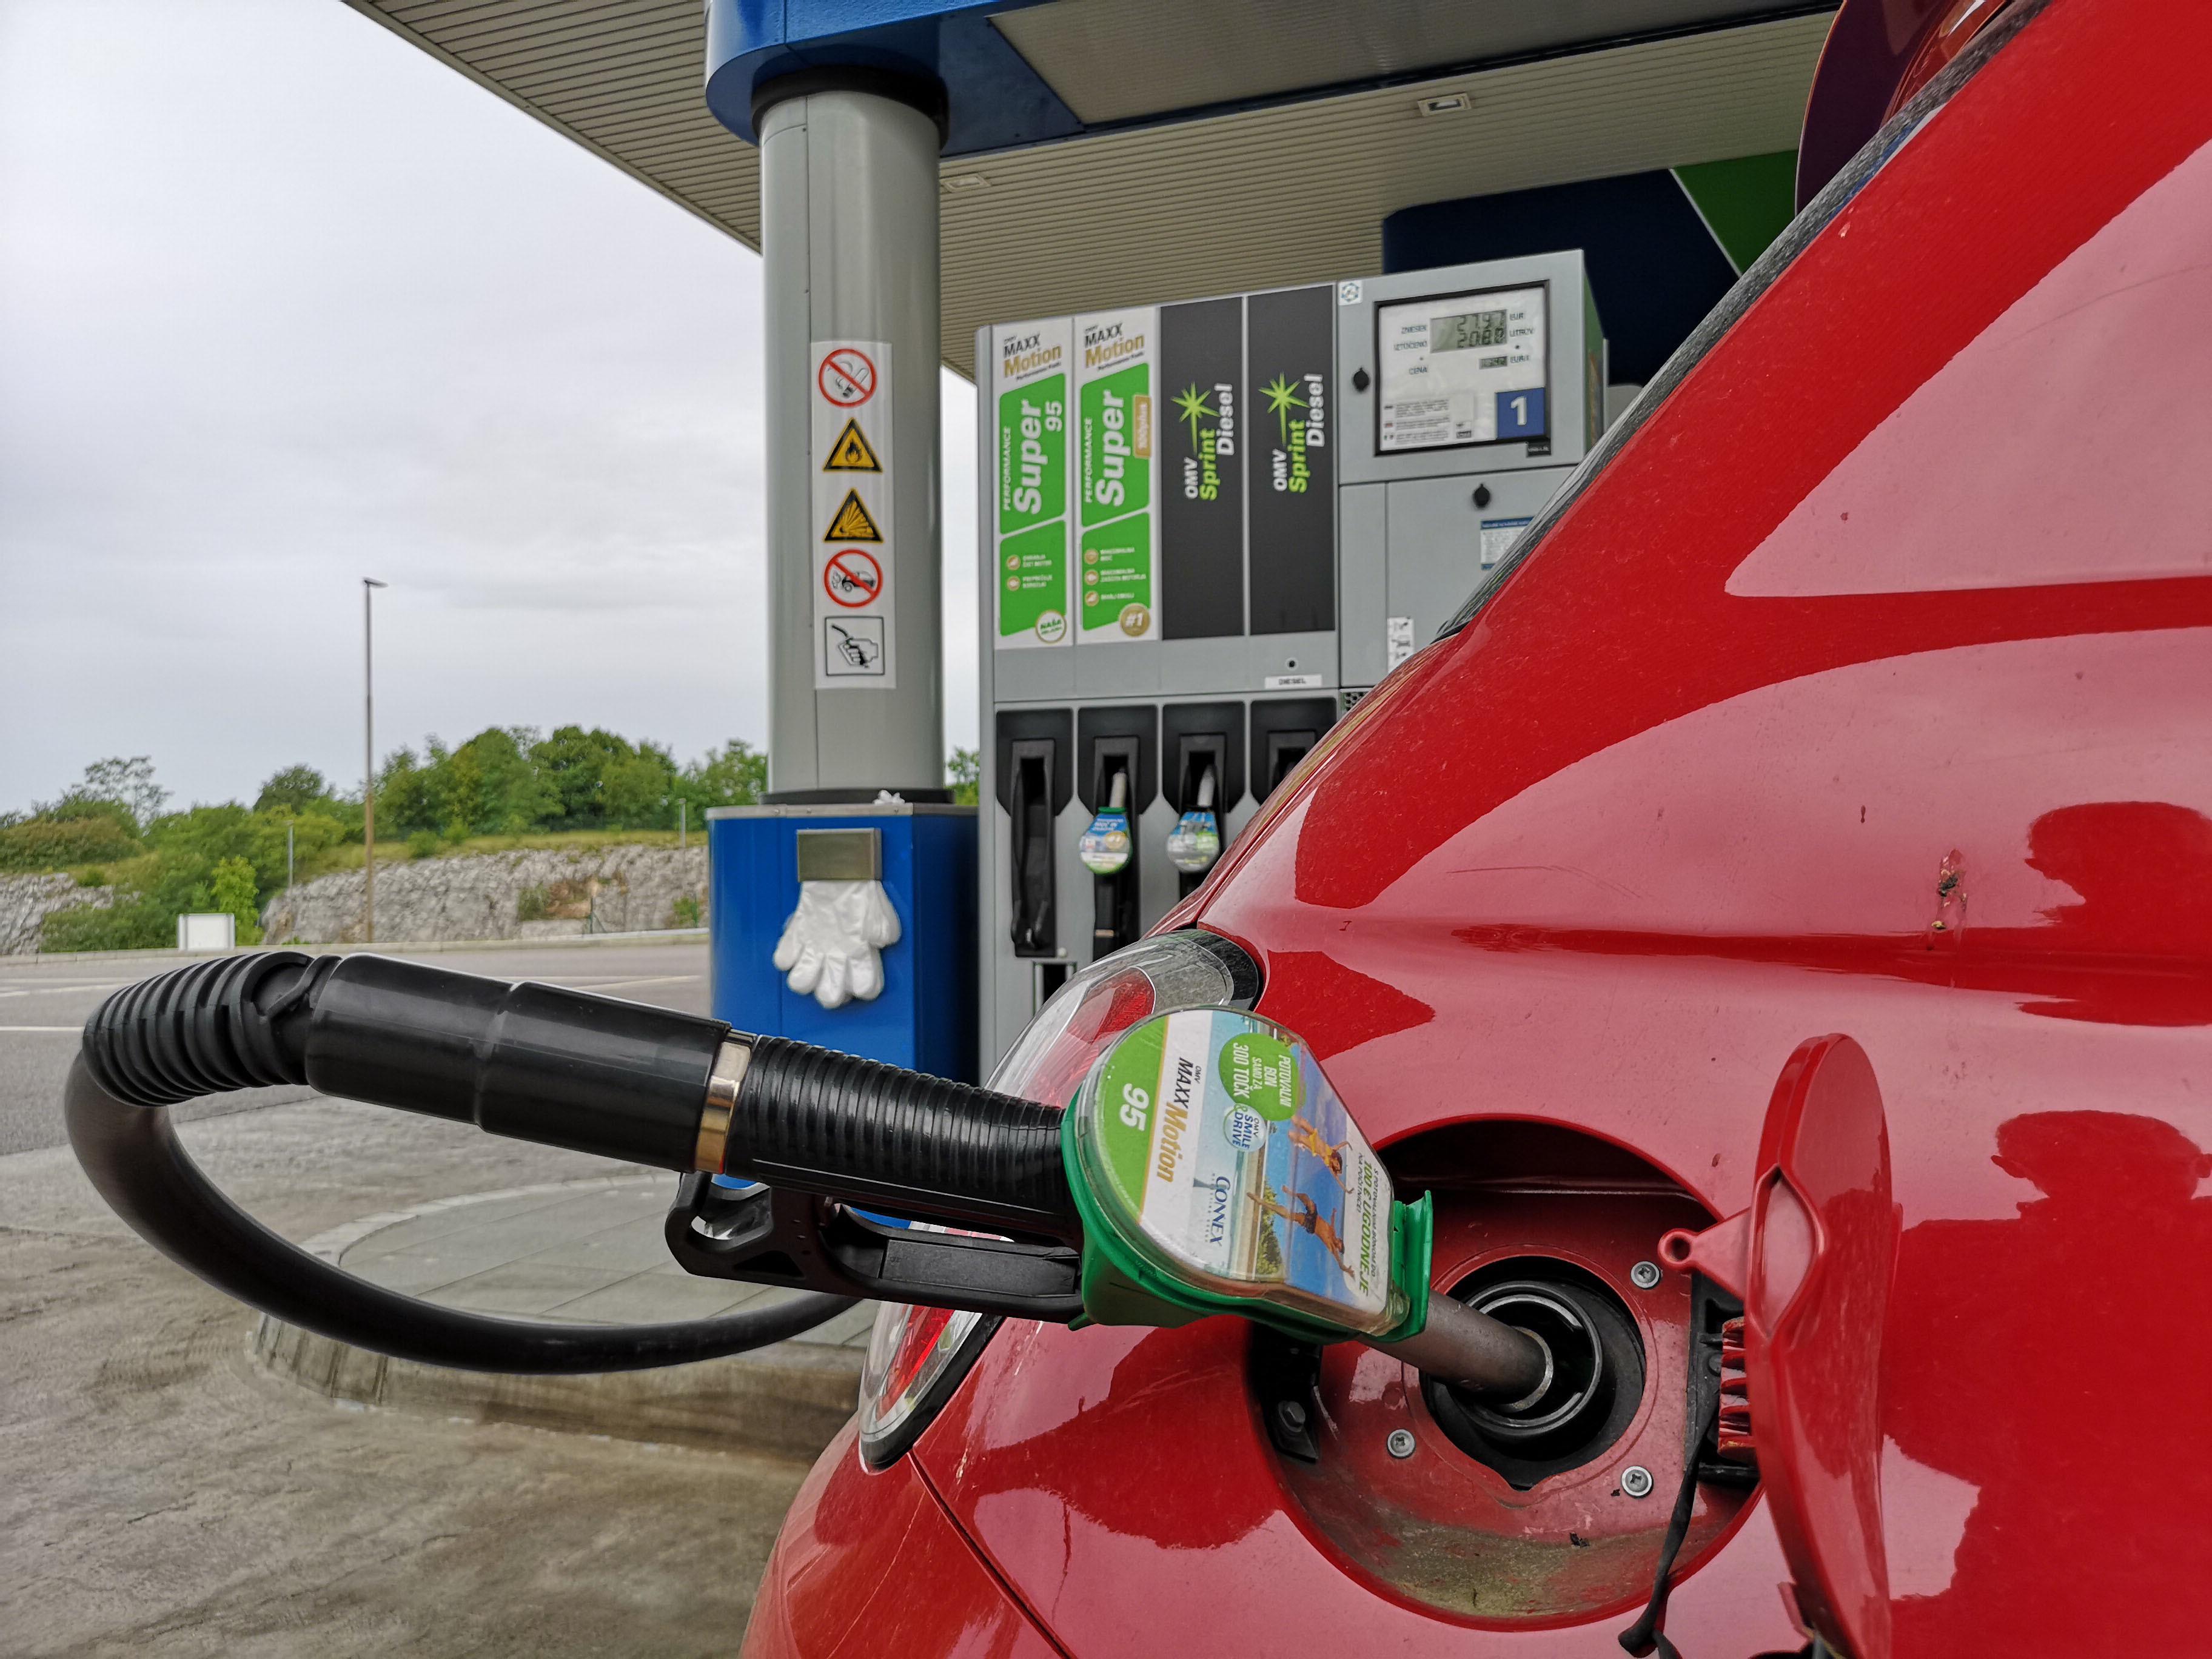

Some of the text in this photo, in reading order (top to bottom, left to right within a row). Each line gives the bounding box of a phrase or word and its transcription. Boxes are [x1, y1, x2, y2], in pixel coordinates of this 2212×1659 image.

[1509, 312, 1524, 321] EUR
[1004, 333, 1041, 358] MAXX
[1085, 323, 1123, 348] MAXX
[1085, 335, 1145, 369] Motion
[1004, 346, 1062, 378] Motion
[1409, 367, 1429, 375] CENA
[1045, 400, 1062, 432] 95
[1214, 383, 1235, 455] Diesel
[1304, 373, 1326, 447] Diesel
[1510, 396, 1527, 425] 1
[1013, 398, 1048, 515] Super
[1084, 417, 1093, 503] PERFORMANCE
[1095, 389, 1131, 507] Super
[1198, 427, 1221, 501] Sprint
[1287, 418, 1311, 493] Sprint
[1184, 456, 1198, 499] OMV
[1272, 447, 1287, 492] OMV
[1125, 612, 1145, 628] #1
[1279, 677, 1307, 686] DIESEL
[1233, 1042, 1254, 1099] 300 TOČK
[1252, 1057, 1263, 1090] SAMO ZA
[1264, 1065, 1278, 1087] BON
[1278, 1054, 1292, 1108] POTOVALNI
[1119, 1083, 1150, 1131] 95
[1156, 1057, 1194, 1183] MAXX Motion
[1232, 1111, 1244, 1146] DRIVE
[1241, 1114, 1253, 1149] SMILE
[1358, 1153, 1364, 1165] NA
[1363, 1161, 1373, 1187] 100
[1210, 1176, 1232, 1247] CONNEX
[1359, 1200, 1372, 1296] UGODNEJE
[1370, 1264, 1376, 1277] DO
